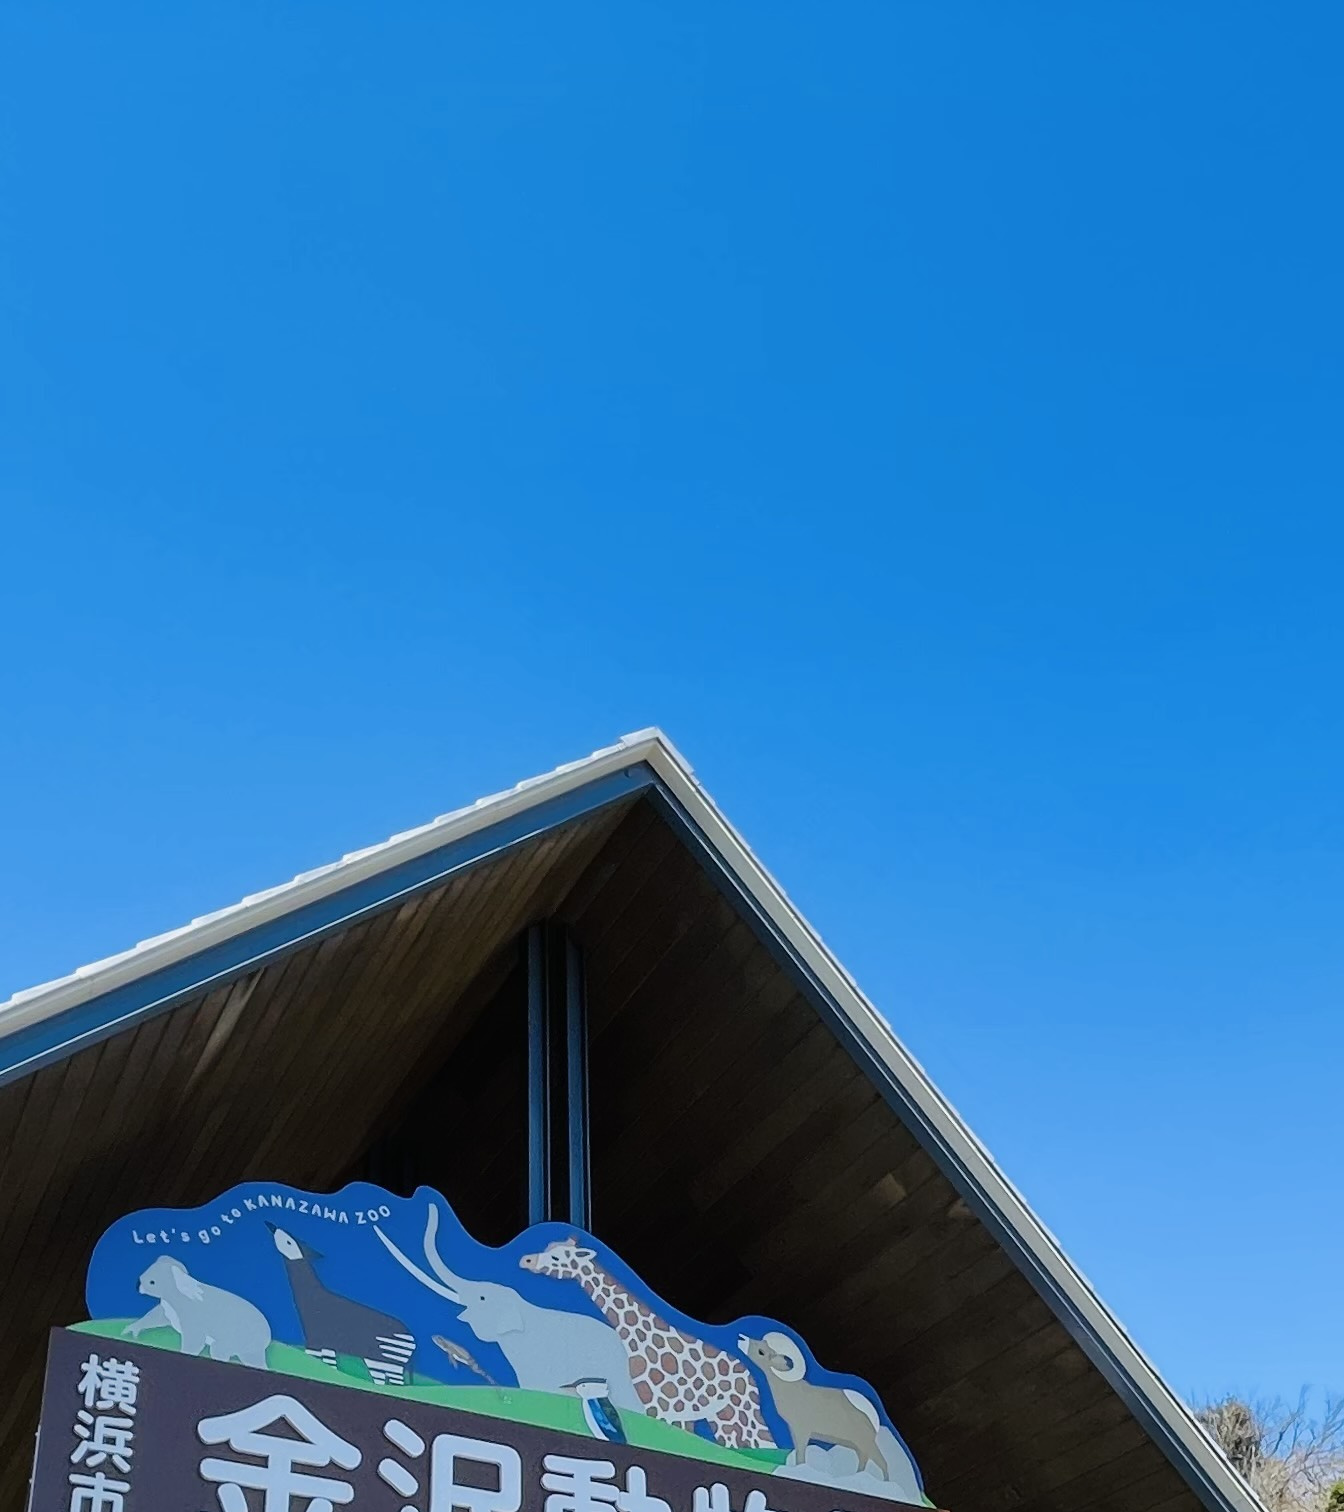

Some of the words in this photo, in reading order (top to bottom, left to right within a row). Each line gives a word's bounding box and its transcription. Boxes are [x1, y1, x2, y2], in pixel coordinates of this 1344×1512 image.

[132, 1229, 190, 1244] Let's
[198, 1225, 221, 1244] go
[221, 1207, 242, 1225] to
[243, 1194, 349, 1224] KANAZAWA
[355, 1204, 392, 1225] ZOO
